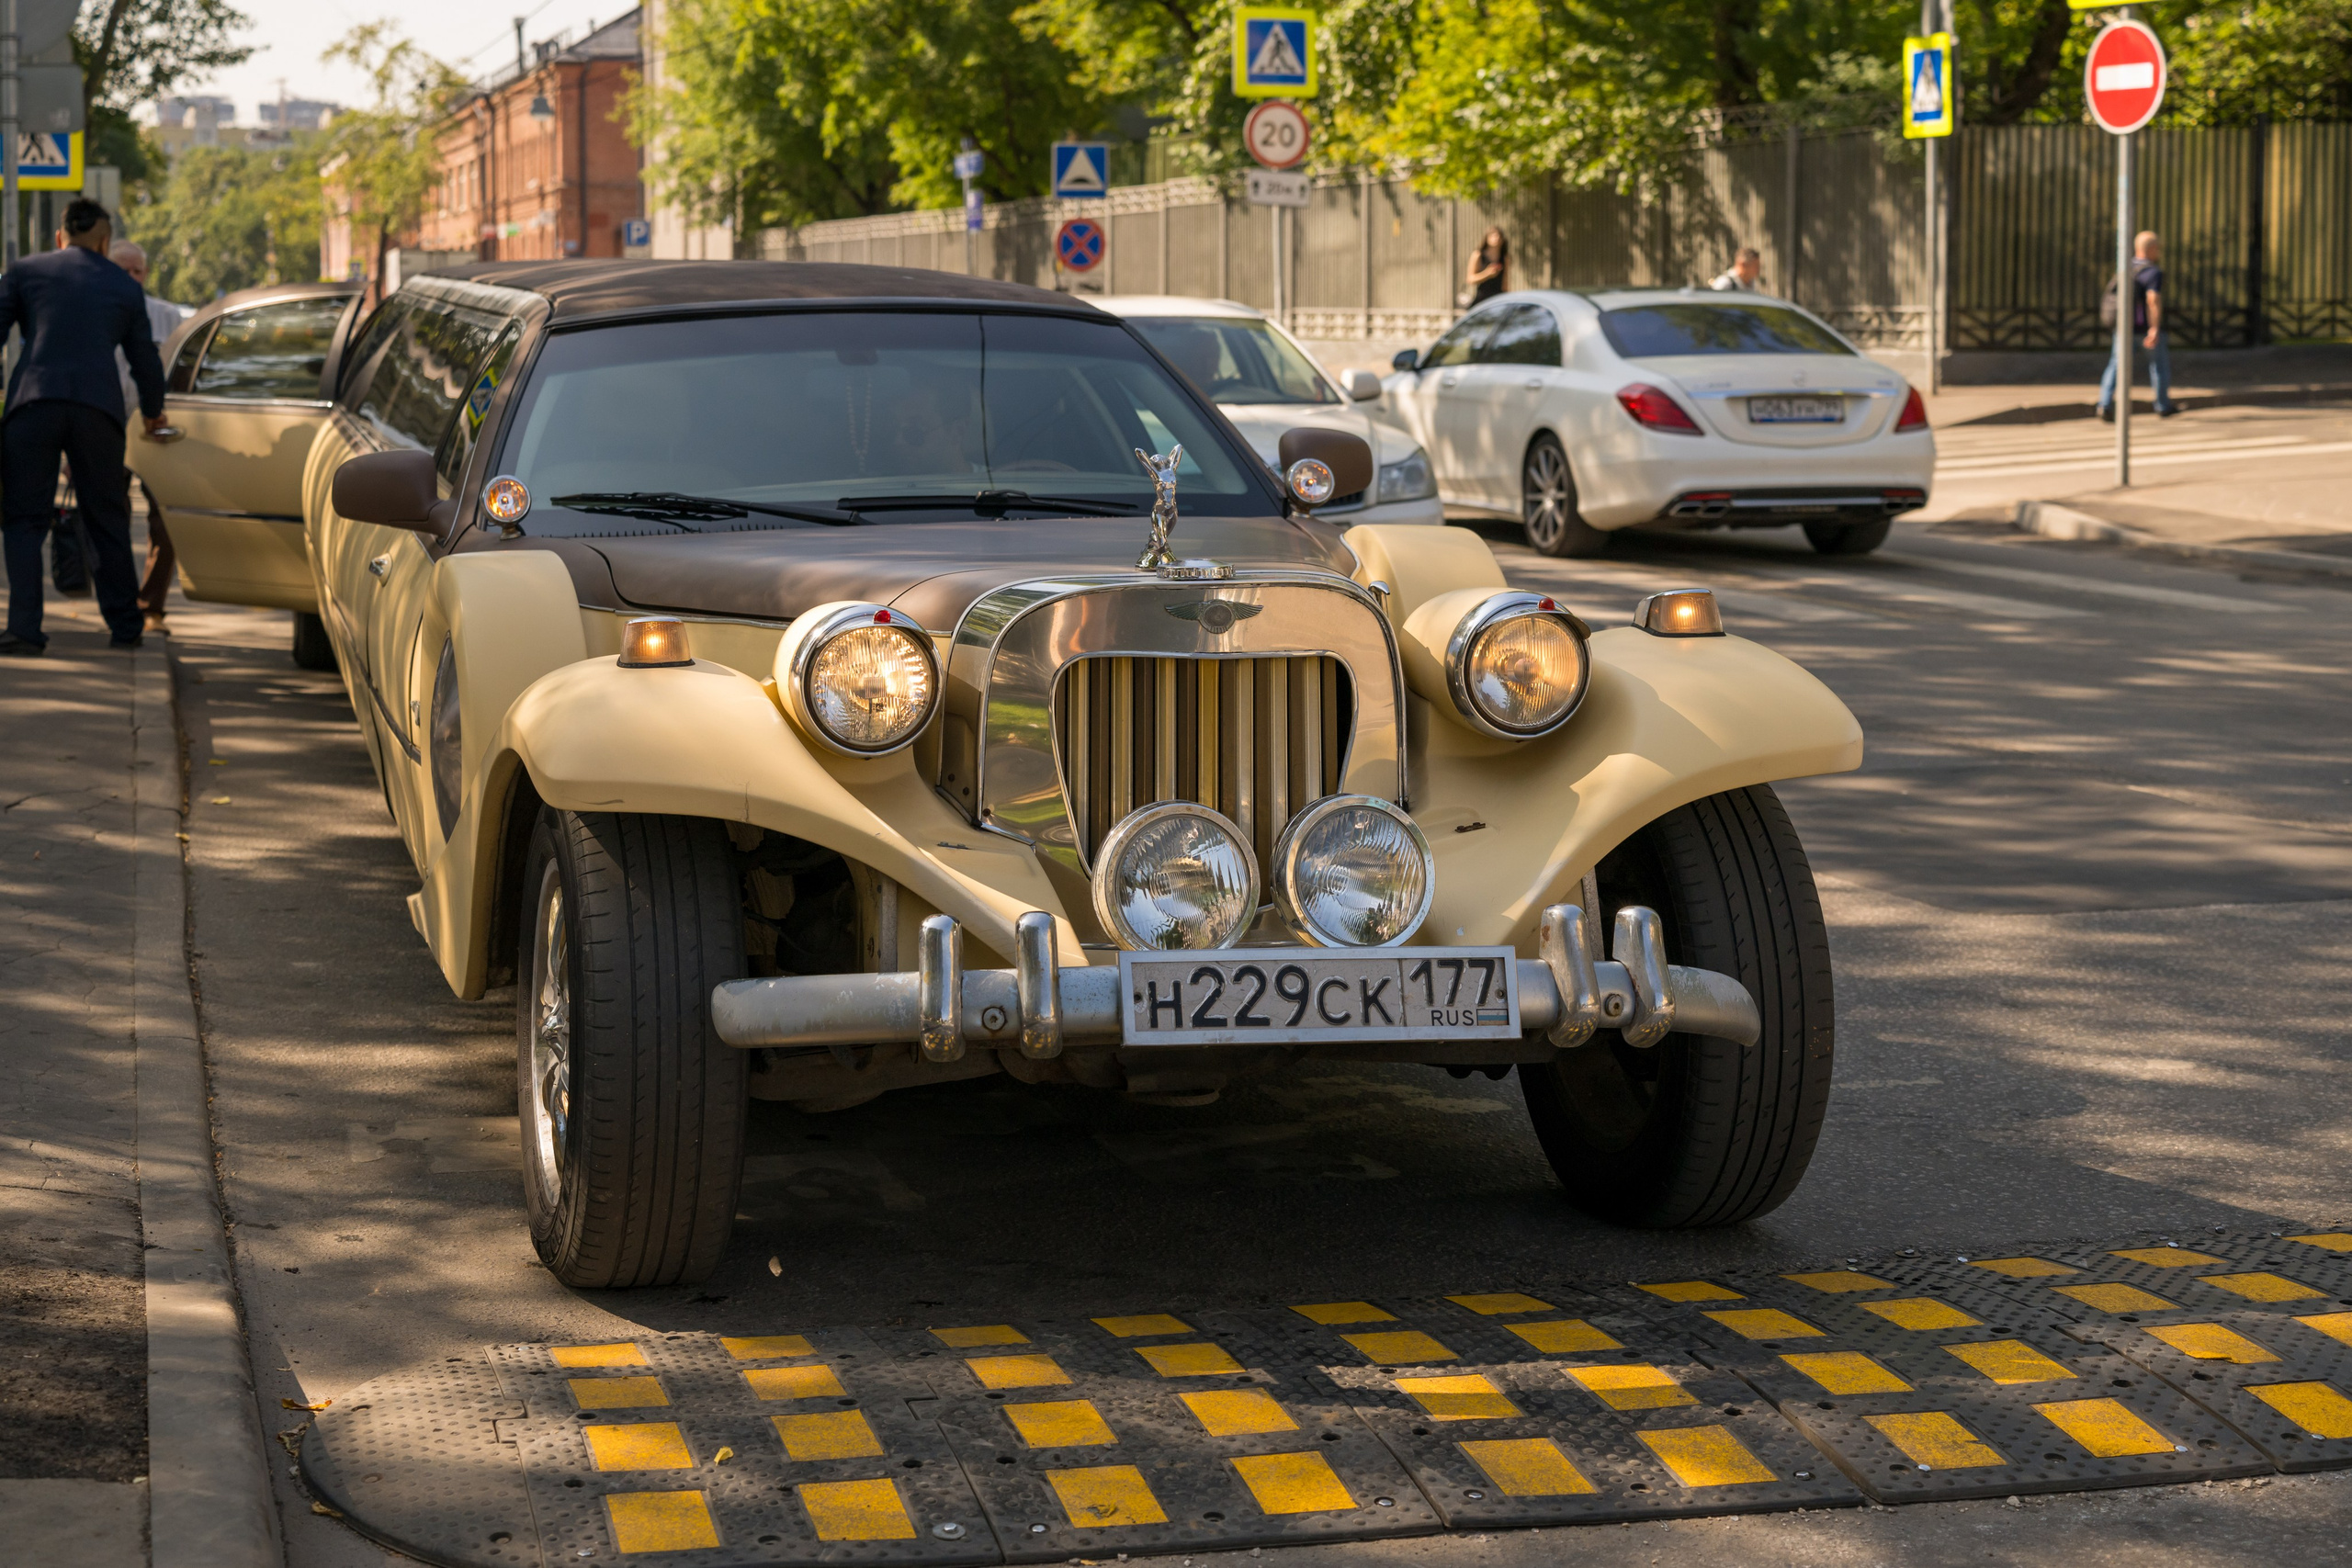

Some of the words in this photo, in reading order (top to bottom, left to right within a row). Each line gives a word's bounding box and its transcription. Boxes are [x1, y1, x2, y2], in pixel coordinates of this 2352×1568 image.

[1261, 121, 1296, 149] 20
[630, 220, 648, 245] P
[1147, 964, 1395, 1029] H229CK
[1409, 959, 1496, 1007] 177
[1430, 1010, 1475, 1027] RUS
